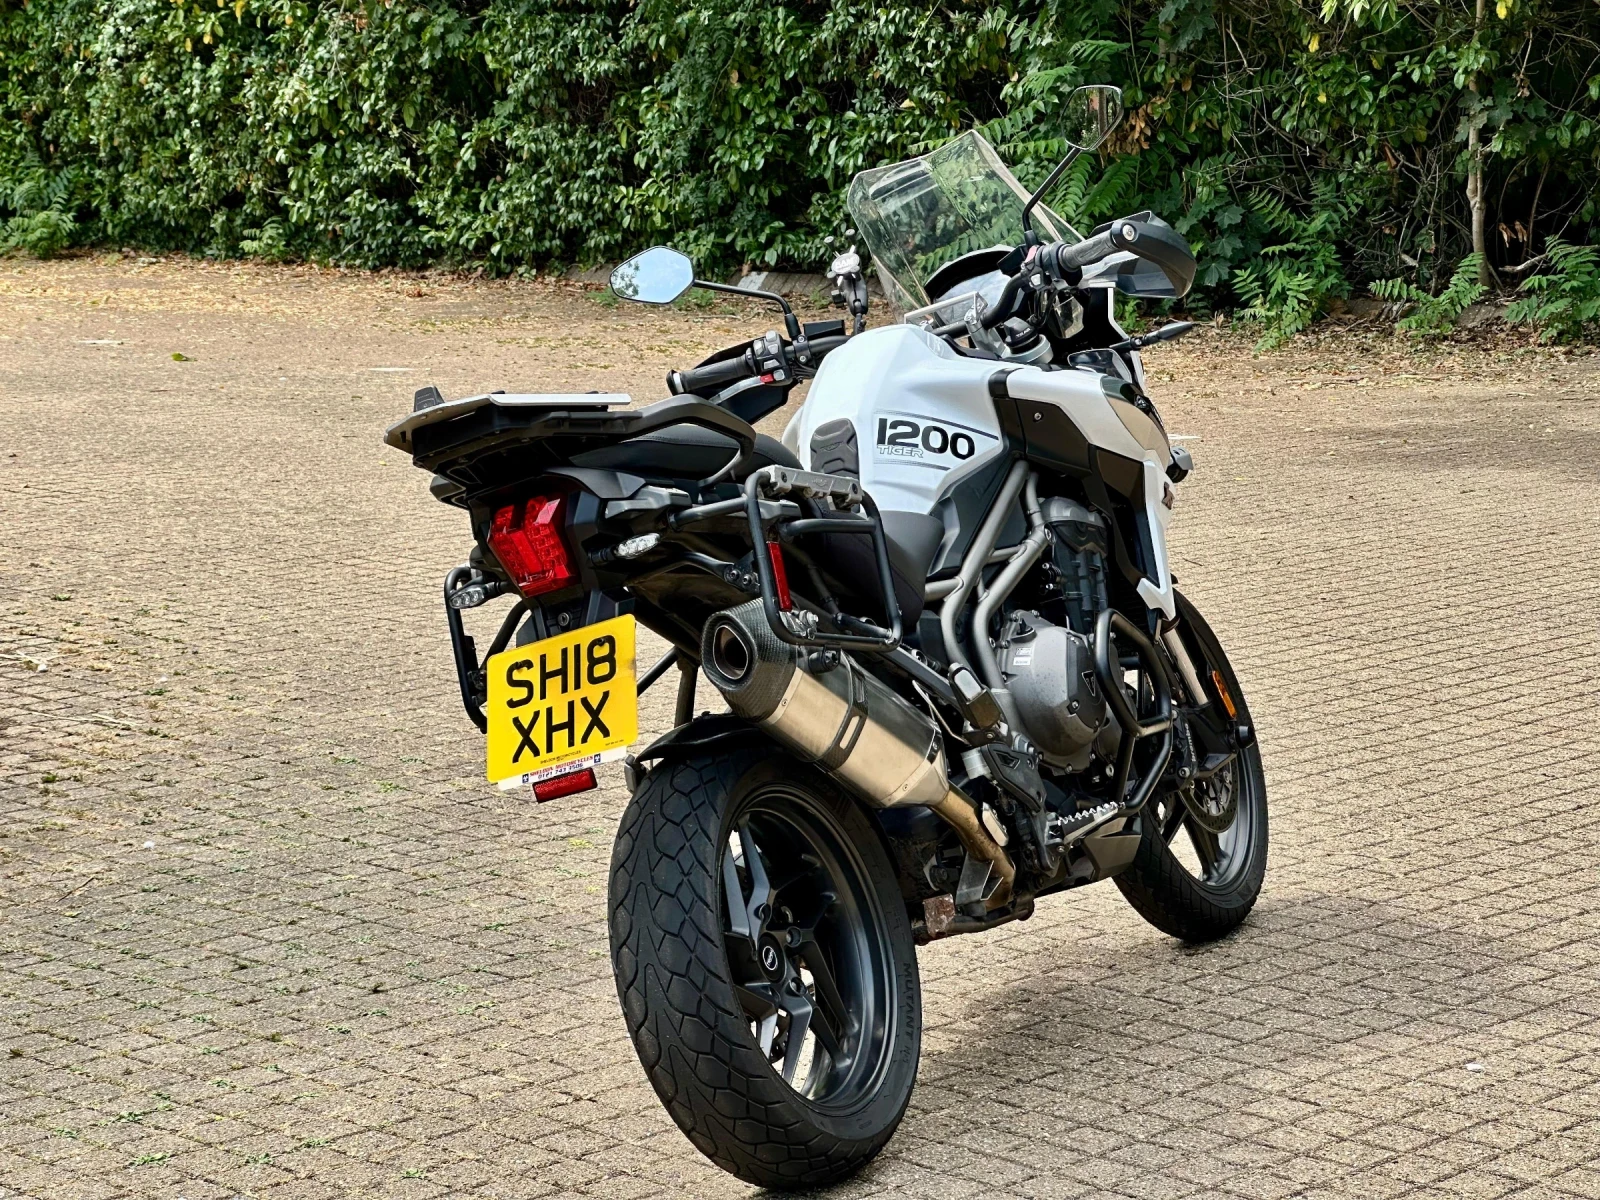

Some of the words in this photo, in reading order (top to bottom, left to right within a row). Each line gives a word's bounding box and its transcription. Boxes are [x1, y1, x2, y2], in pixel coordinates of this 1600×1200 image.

[876, 417, 976, 460] 1200
[876, 443, 924, 459] TIGER
[506, 634, 617, 709] SH18
[511, 690, 611, 764] XHX
[555, 755, 594, 769] MOTORCYCLES
[903, 962, 914, 1040] MUTANT
